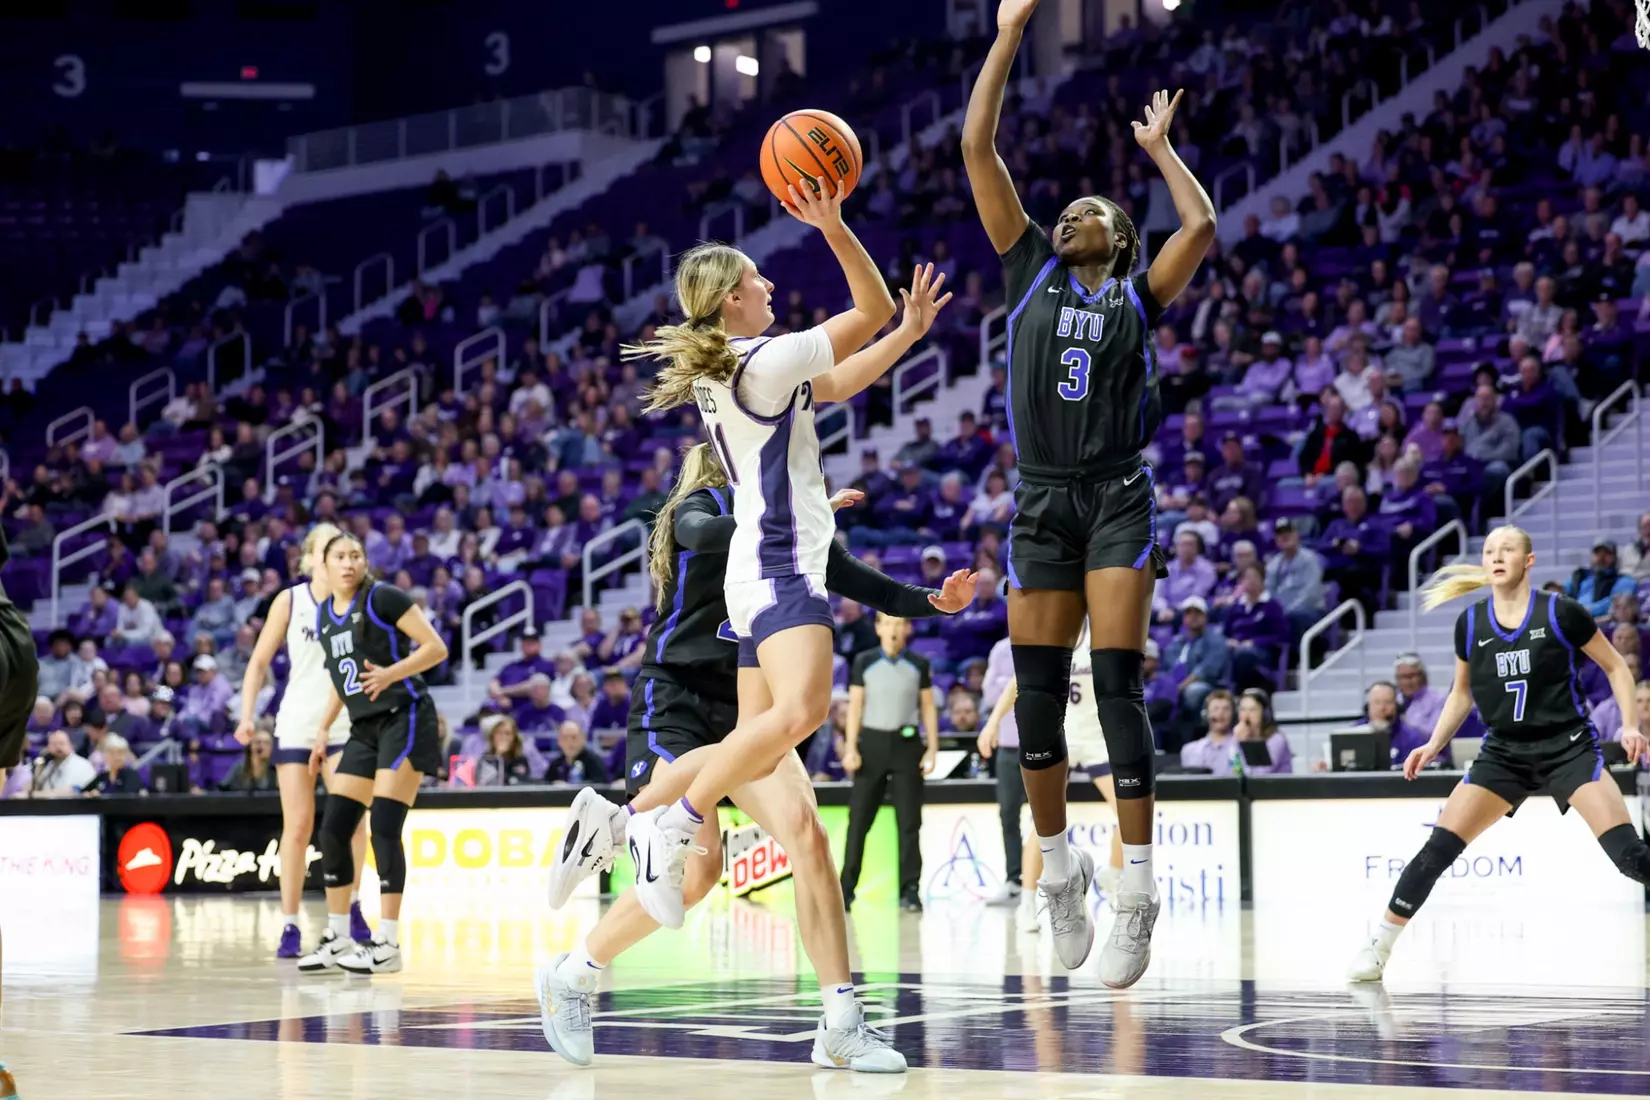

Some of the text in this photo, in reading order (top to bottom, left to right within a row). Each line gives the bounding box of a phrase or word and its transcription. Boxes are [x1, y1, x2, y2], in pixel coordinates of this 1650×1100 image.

[484, 32, 510, 75] 3
[52, 55, 86, 97] 3
[1056, 306, 1104, 342] BYU
[1057, 347, 1091, 401] 3
[338, 657, 363, 696] 2
[1495, 649, 1531, 677] BYU
[1505, 679, 1528, 722] 7
[174, 838, 324, 884] Pizza Ht
[1365, 854, 1523, 880] FRDOM
